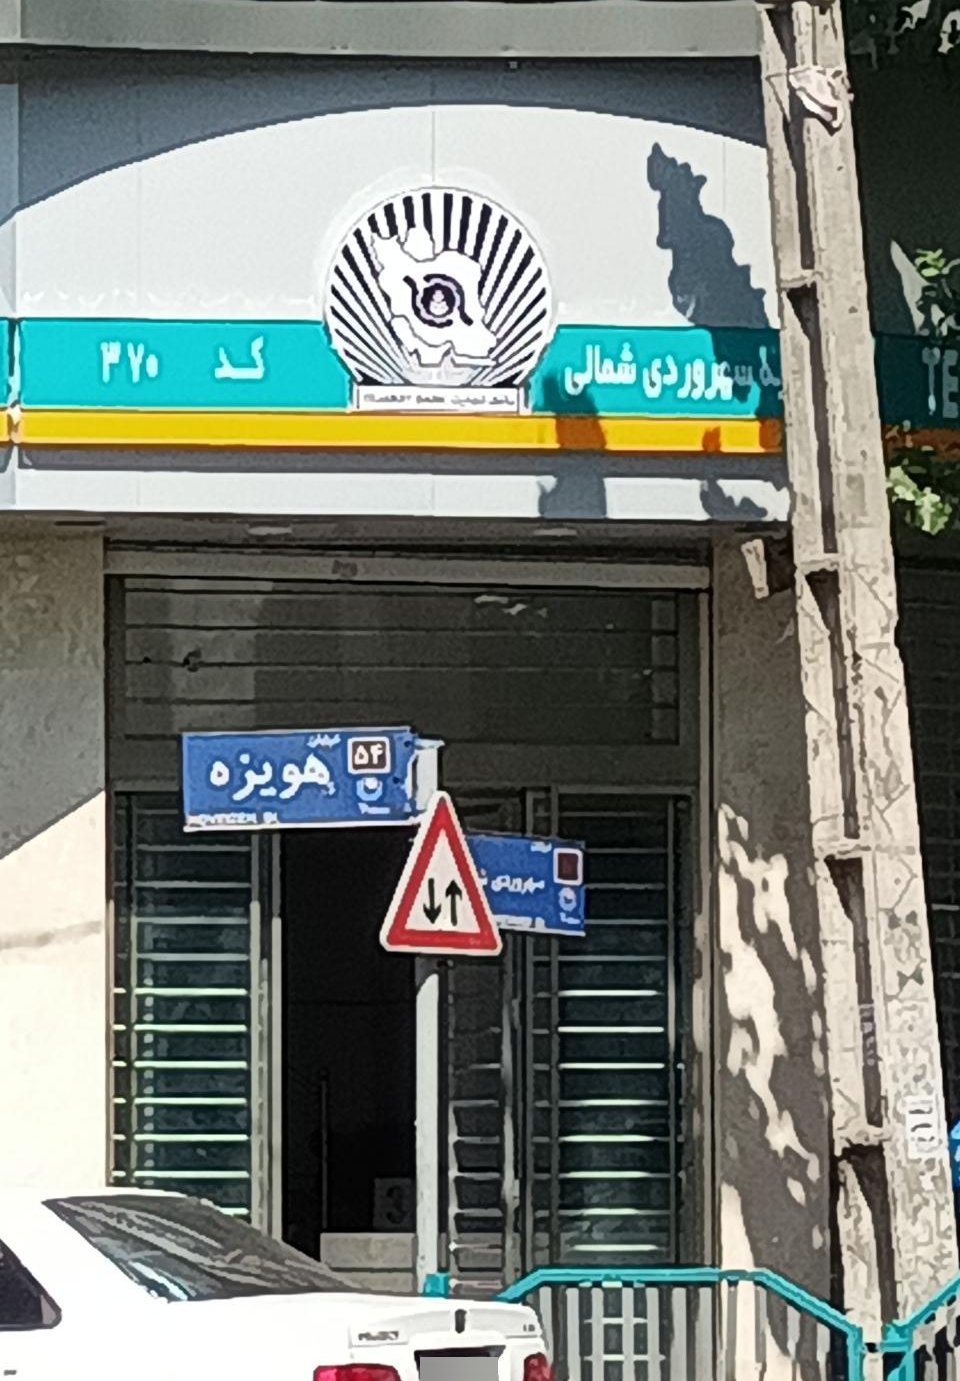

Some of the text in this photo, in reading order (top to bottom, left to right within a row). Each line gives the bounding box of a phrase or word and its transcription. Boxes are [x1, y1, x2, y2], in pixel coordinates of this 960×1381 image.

[214, 335, 266, 380] کد
[564, 342, 637, 396] شمالی
[642, 353, 756, 401] سهروردی
[209, 753, 332, 802] هویزه
[354, 743, 384, 766] ۵۴
